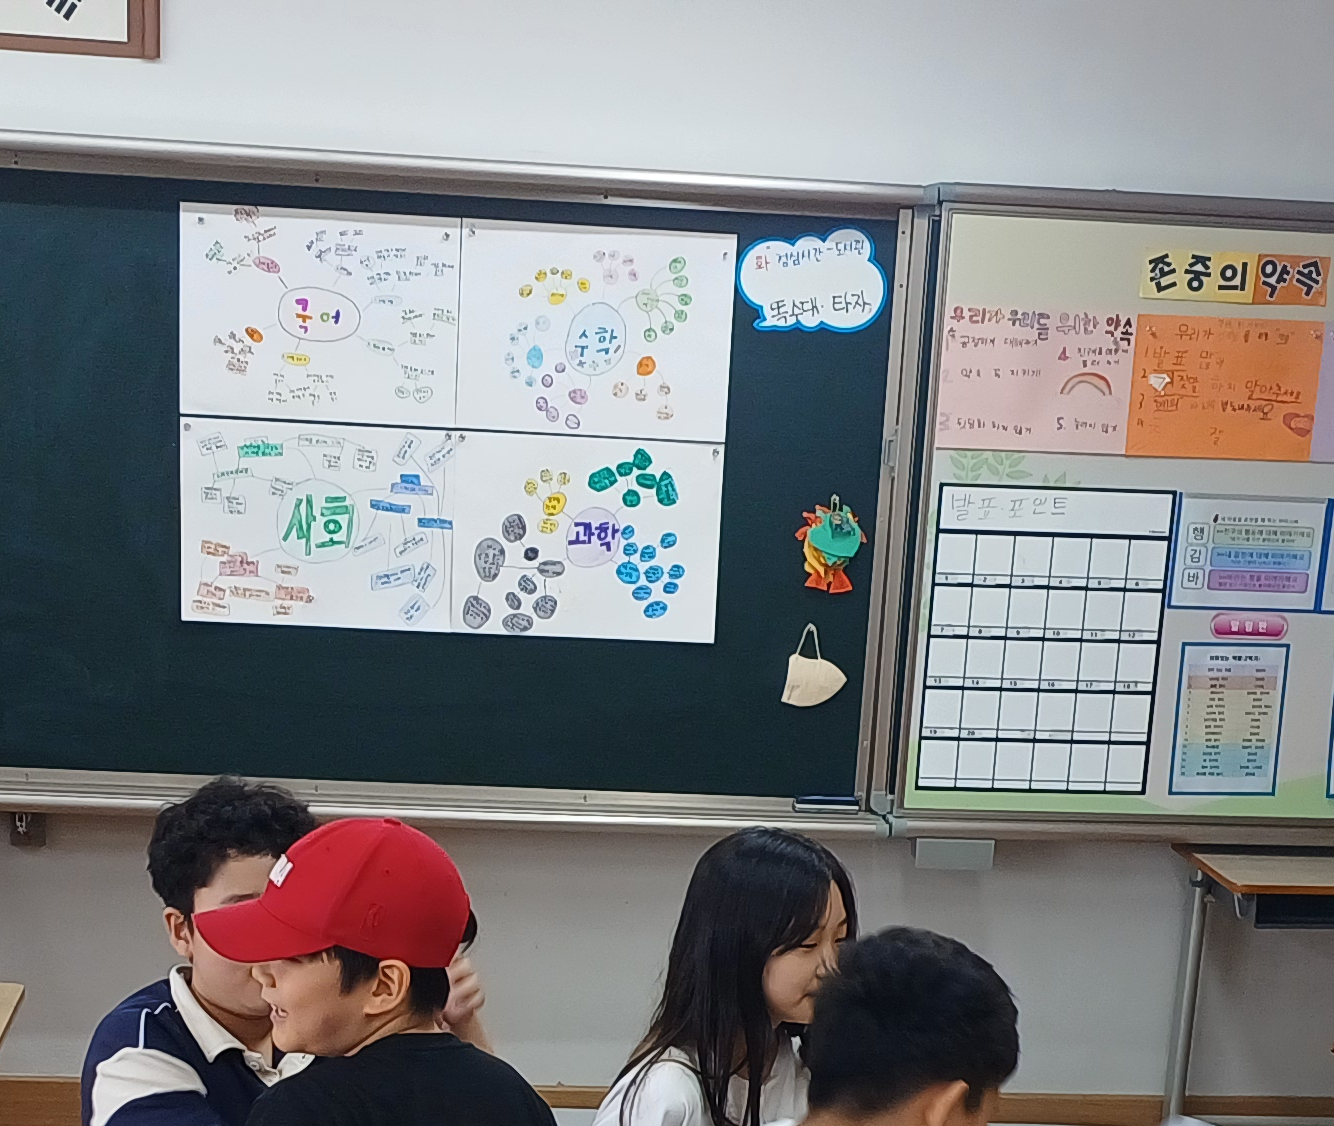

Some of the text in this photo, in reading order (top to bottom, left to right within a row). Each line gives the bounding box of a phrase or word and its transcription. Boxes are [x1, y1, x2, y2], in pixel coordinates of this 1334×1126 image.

[1148, 253, 1323, 299] 존중의 약속
[295, 298, 341, 334] 국어
[1174, 323, 1215, 342] 우리가
[574, 326, 619, 357] 수학
[281, 494, 355, 556] 사회
[567, 521, 620, 552] 과학
